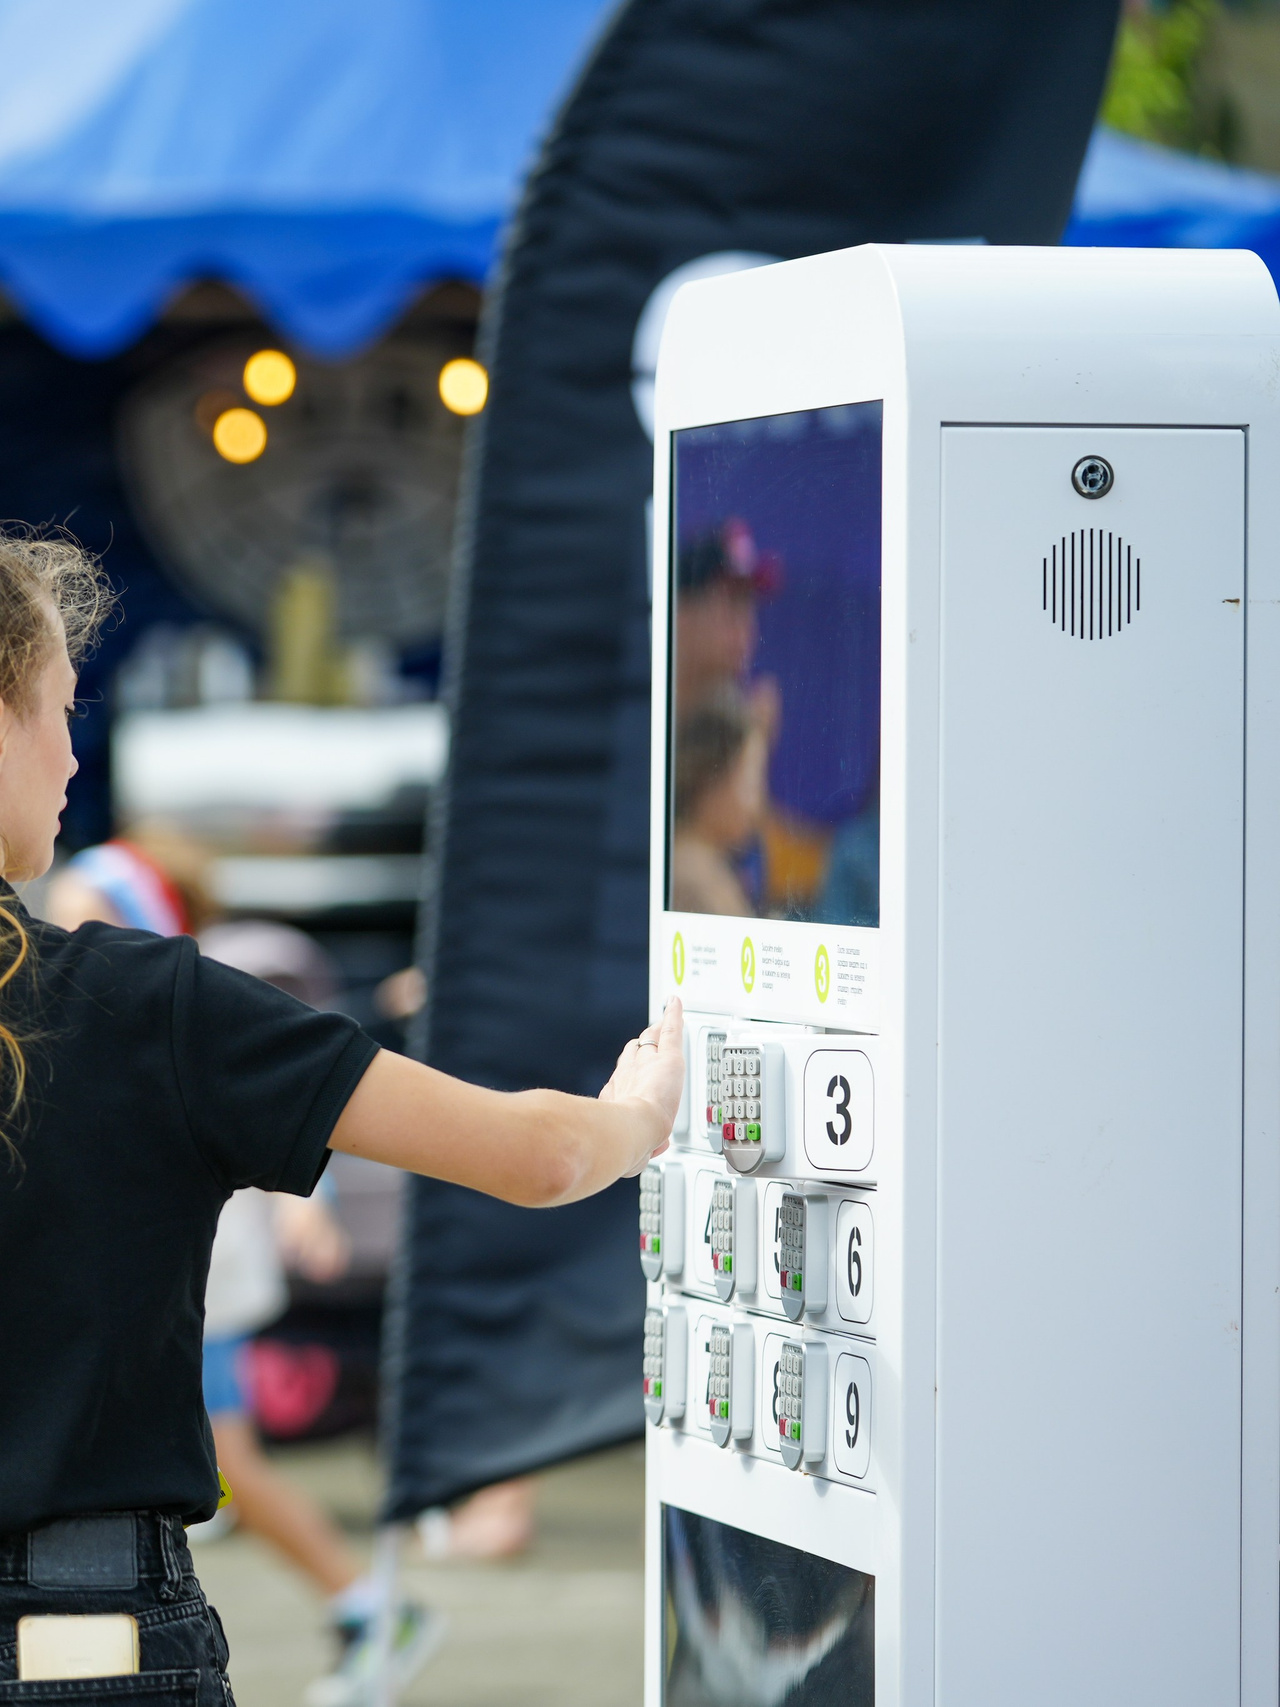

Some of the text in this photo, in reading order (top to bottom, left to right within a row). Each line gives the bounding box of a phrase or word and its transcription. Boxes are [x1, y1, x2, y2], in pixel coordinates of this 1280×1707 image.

[675, 939, 682, 978] 1
[744, 945, 754, 984] 2
[818, 954, 827, 993] 3
[826, 1075, 852, 1146] 3
[848, 1226, 862, 1297] 6
[845, 1382, 860, 1449] 9
